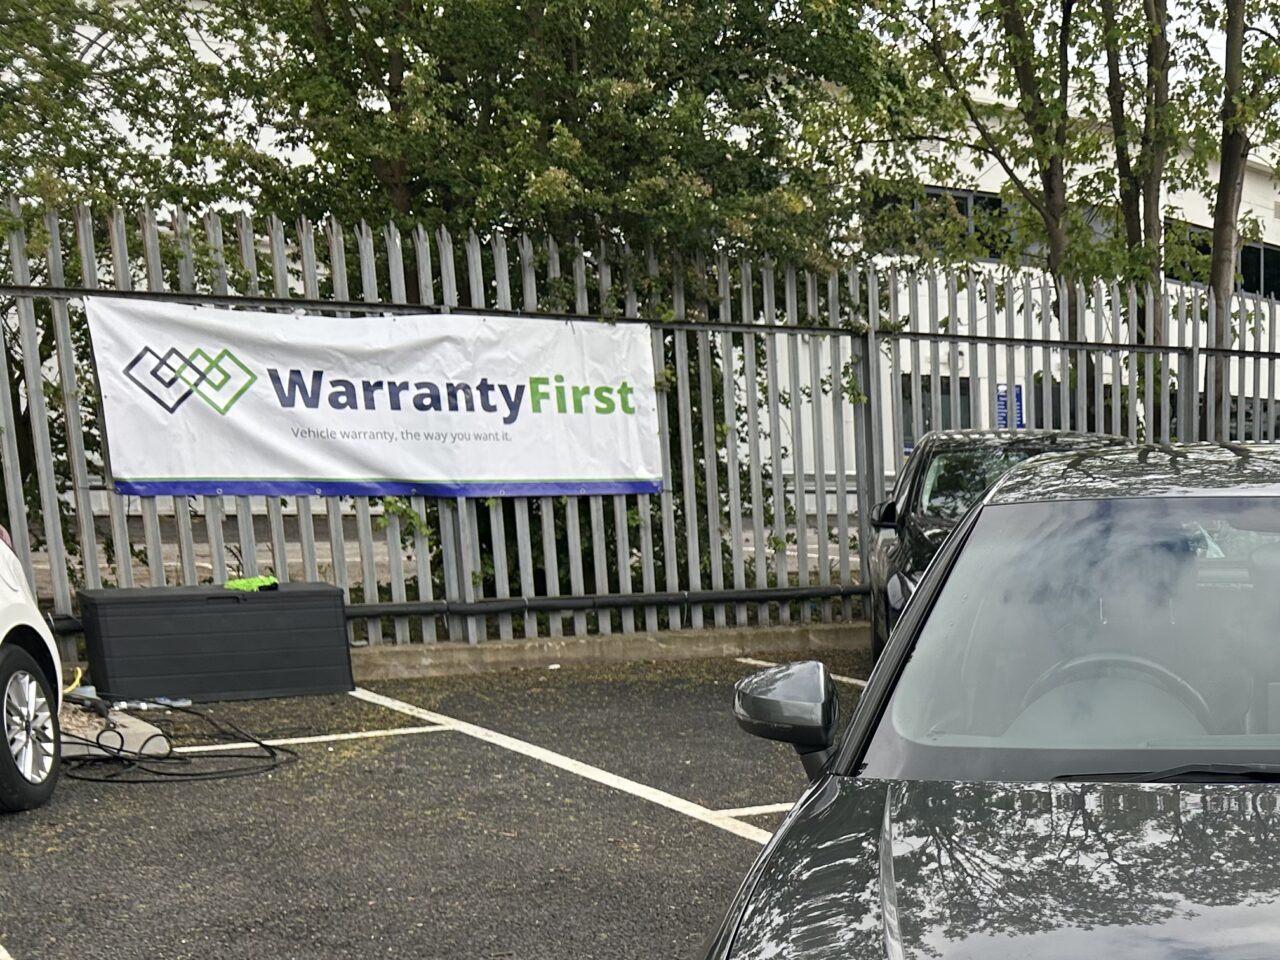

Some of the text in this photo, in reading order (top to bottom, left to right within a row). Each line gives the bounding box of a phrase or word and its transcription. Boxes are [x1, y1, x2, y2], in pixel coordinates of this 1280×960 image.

[267, 366, 635, 425] WarrantyFirst
[291, 427, 512, 443] Vehicle warranty, the way you want it.
